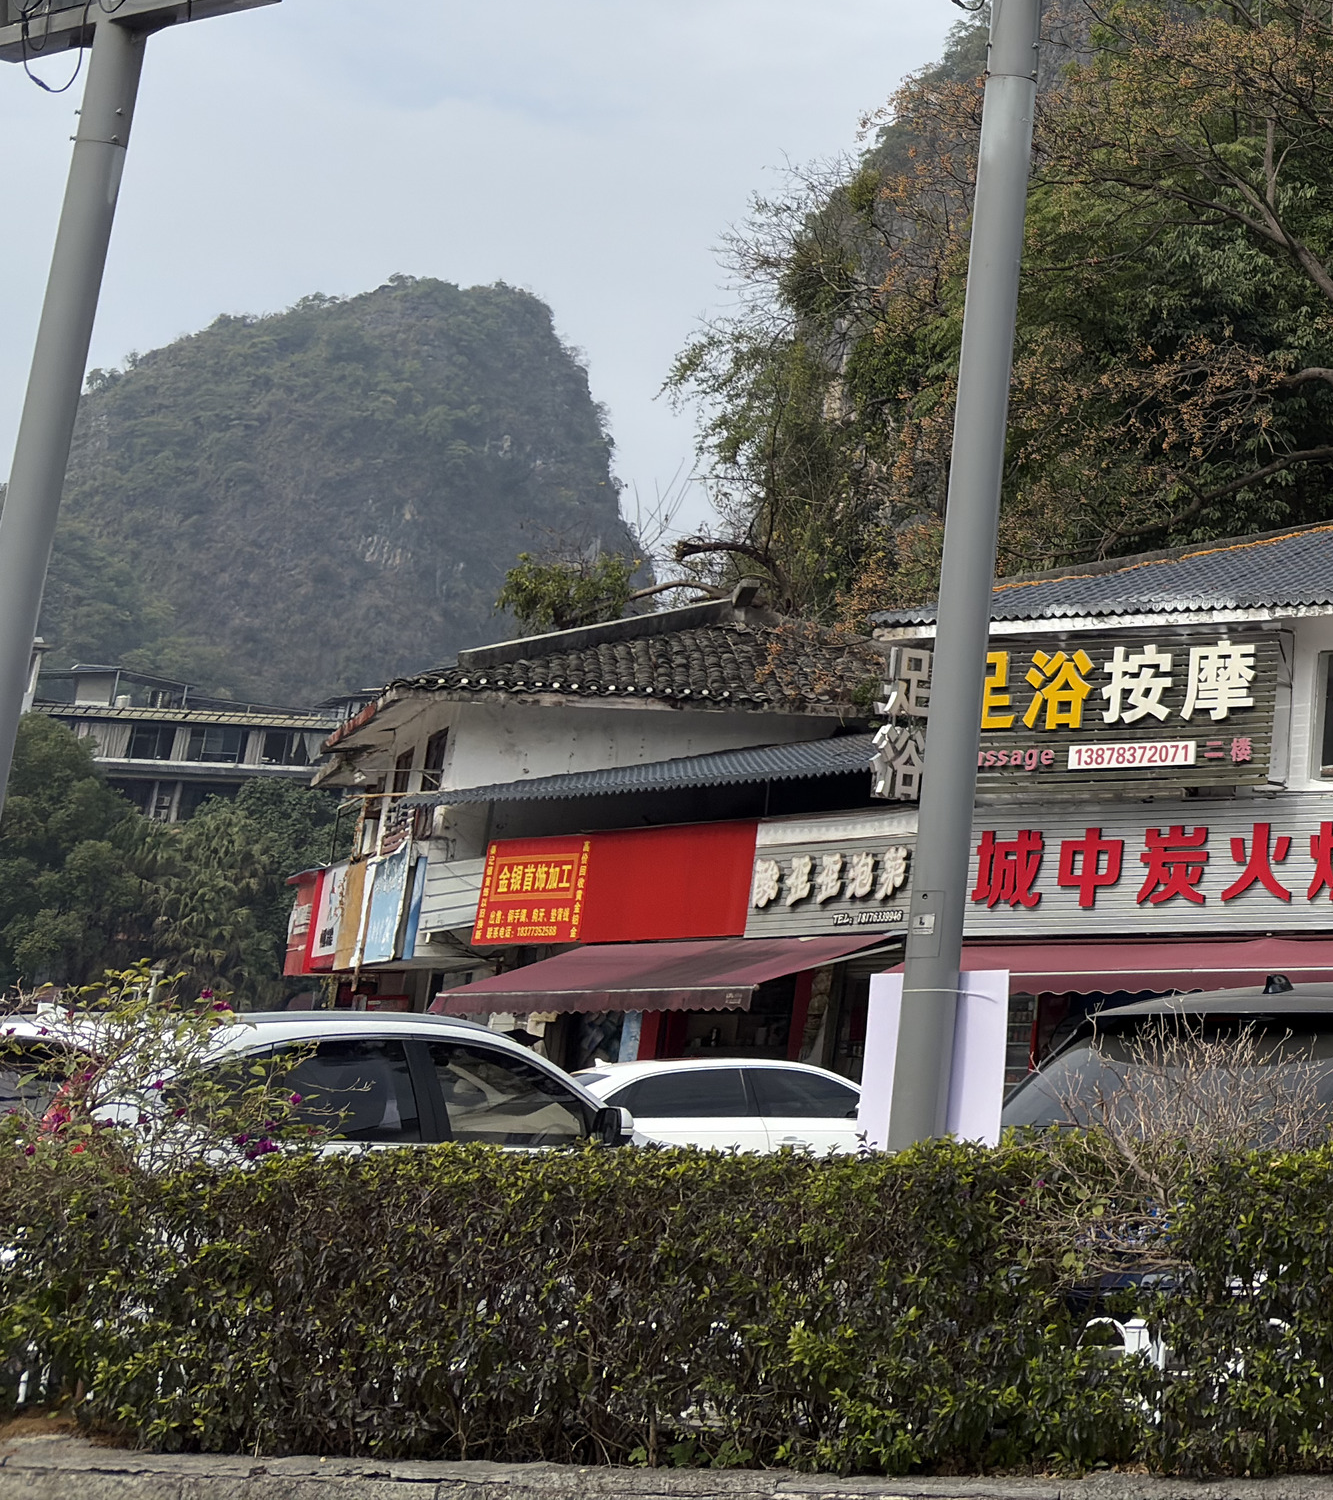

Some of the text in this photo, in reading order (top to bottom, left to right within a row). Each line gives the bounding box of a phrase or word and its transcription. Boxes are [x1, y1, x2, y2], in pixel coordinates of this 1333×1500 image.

[978, 747, 1054, 771] ssage
[1075, 744, 1190, 767] 13878372071
[1204, 738, 1252, 763] 二楼
[497, 863, 572, 893] 金银首饰加工
